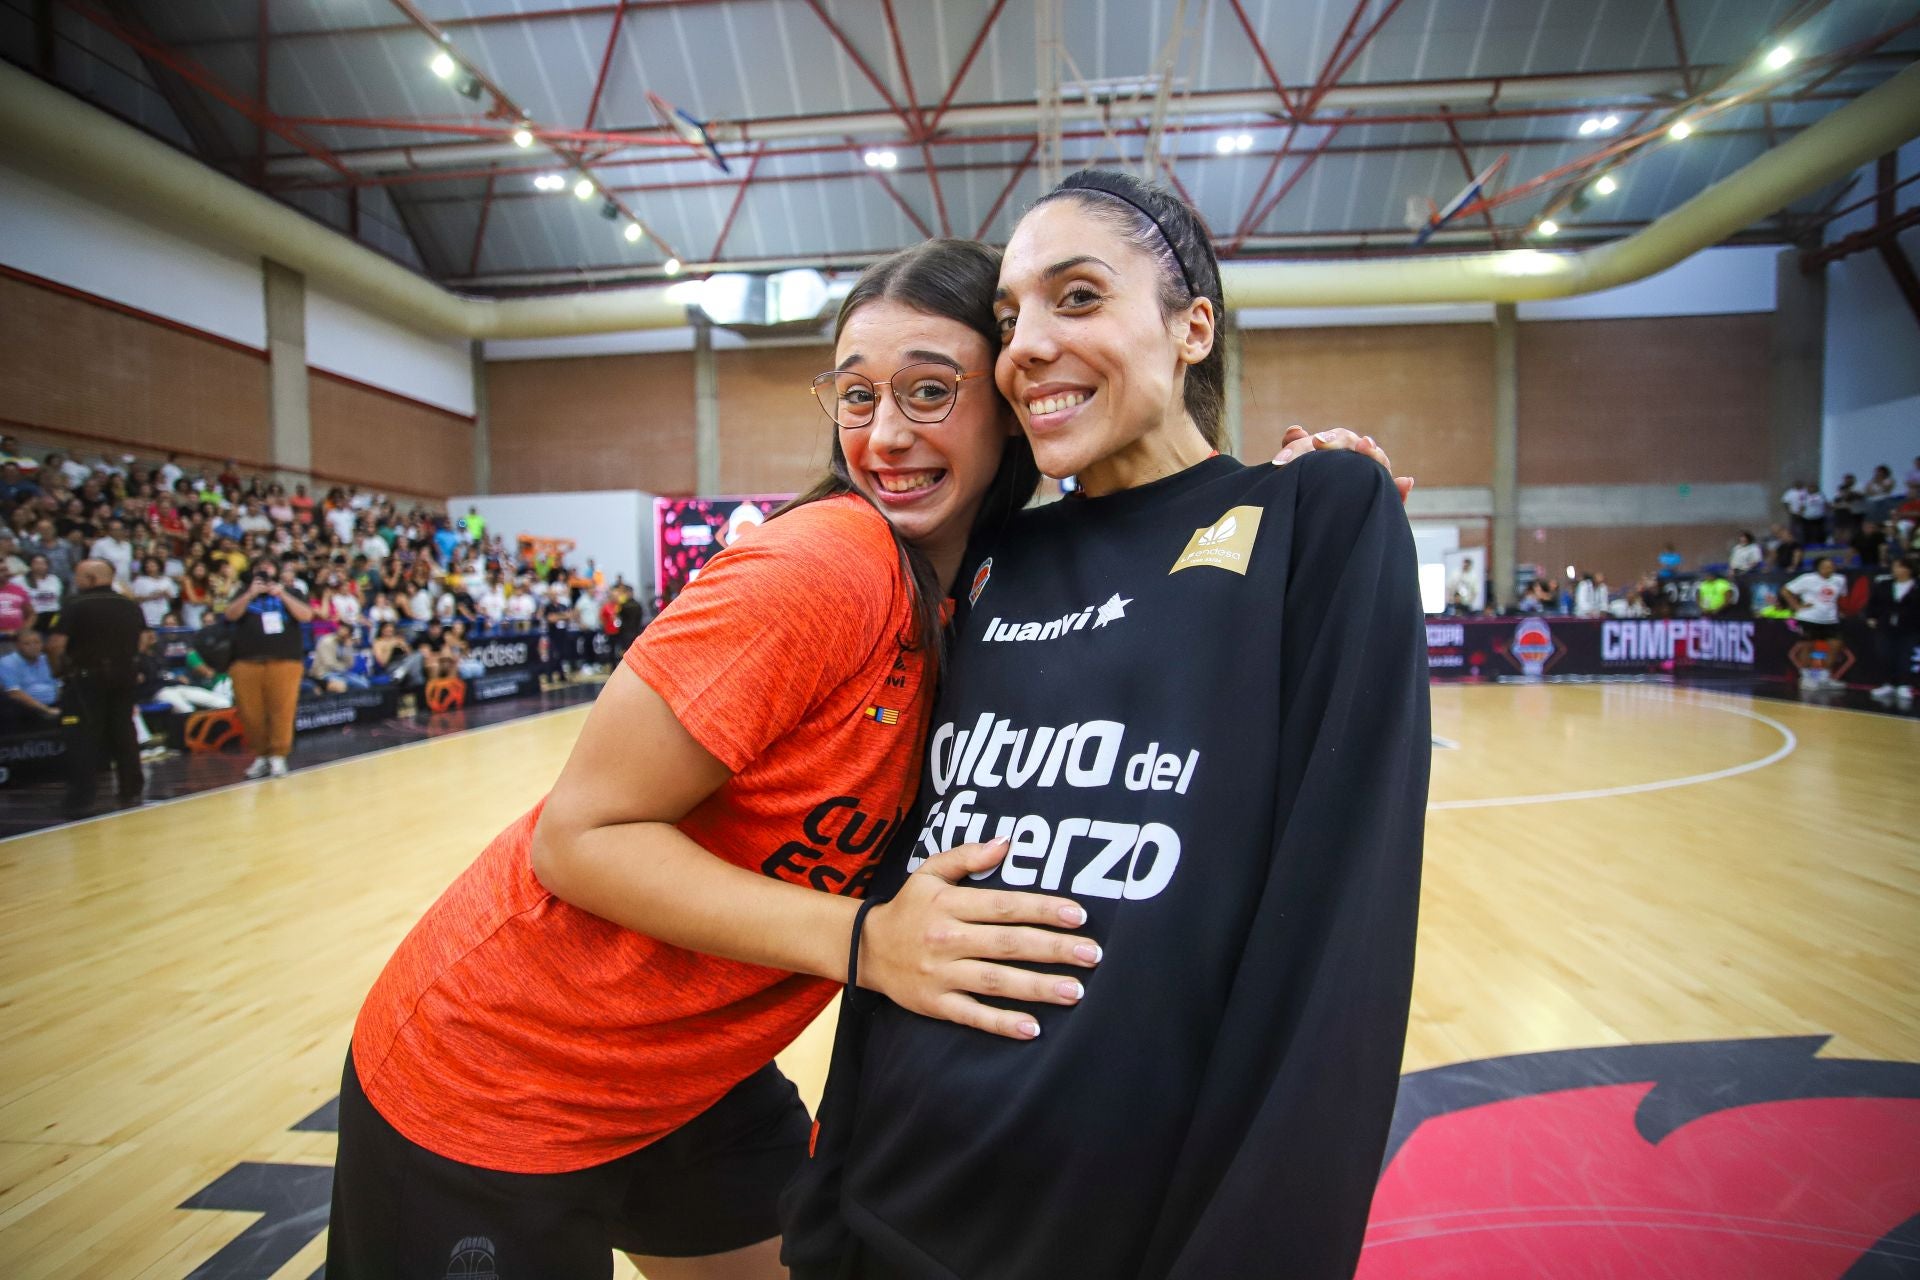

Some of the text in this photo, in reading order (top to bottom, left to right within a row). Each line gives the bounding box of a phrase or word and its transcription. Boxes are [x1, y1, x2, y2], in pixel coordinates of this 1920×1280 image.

[982, 606, 1096, 643] luanvi
[1602, 619, 1755, 664] CAMPEONAS
[1125, 742, 1200, 795] del
[803, 796, 902, 861] Cul
